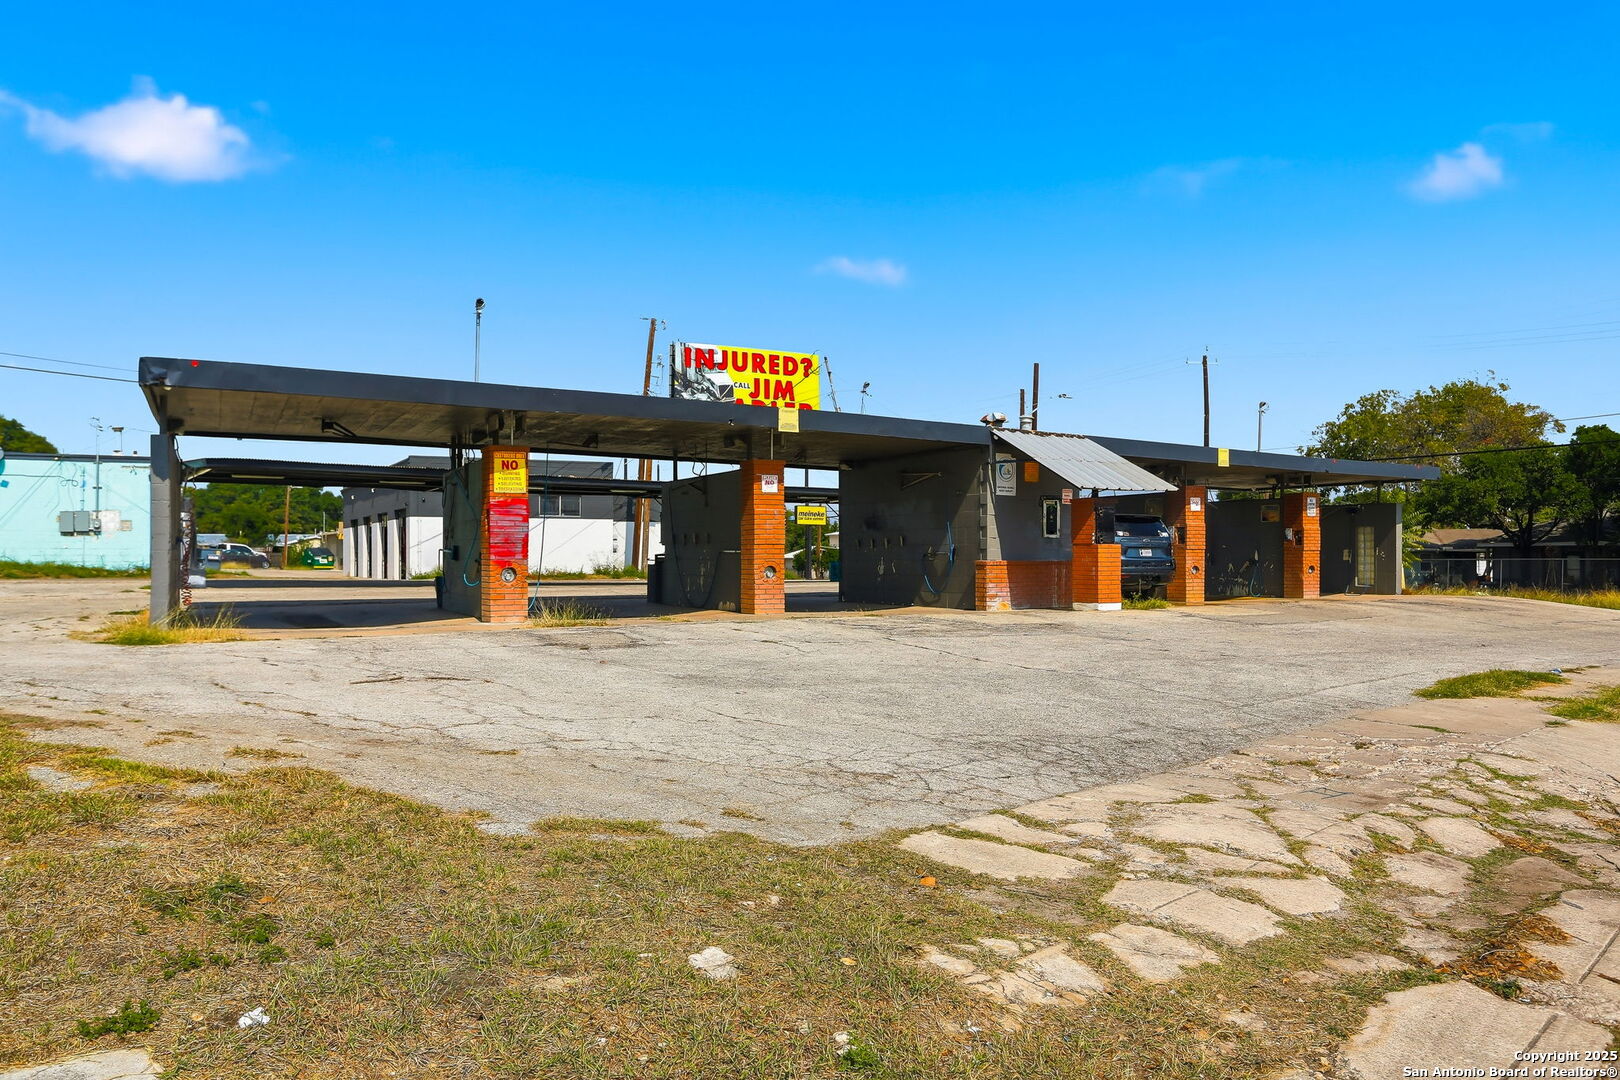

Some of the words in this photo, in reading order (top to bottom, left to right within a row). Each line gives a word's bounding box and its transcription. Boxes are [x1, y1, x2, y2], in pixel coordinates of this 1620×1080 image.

[684, 347, 813, 378] INJURED?
[733, 381, 750, 389] CALL
[749, 377, 795, 402] JIM
[501, 460, 519, 470] NO
[798, 510, 825, 518] meineke
